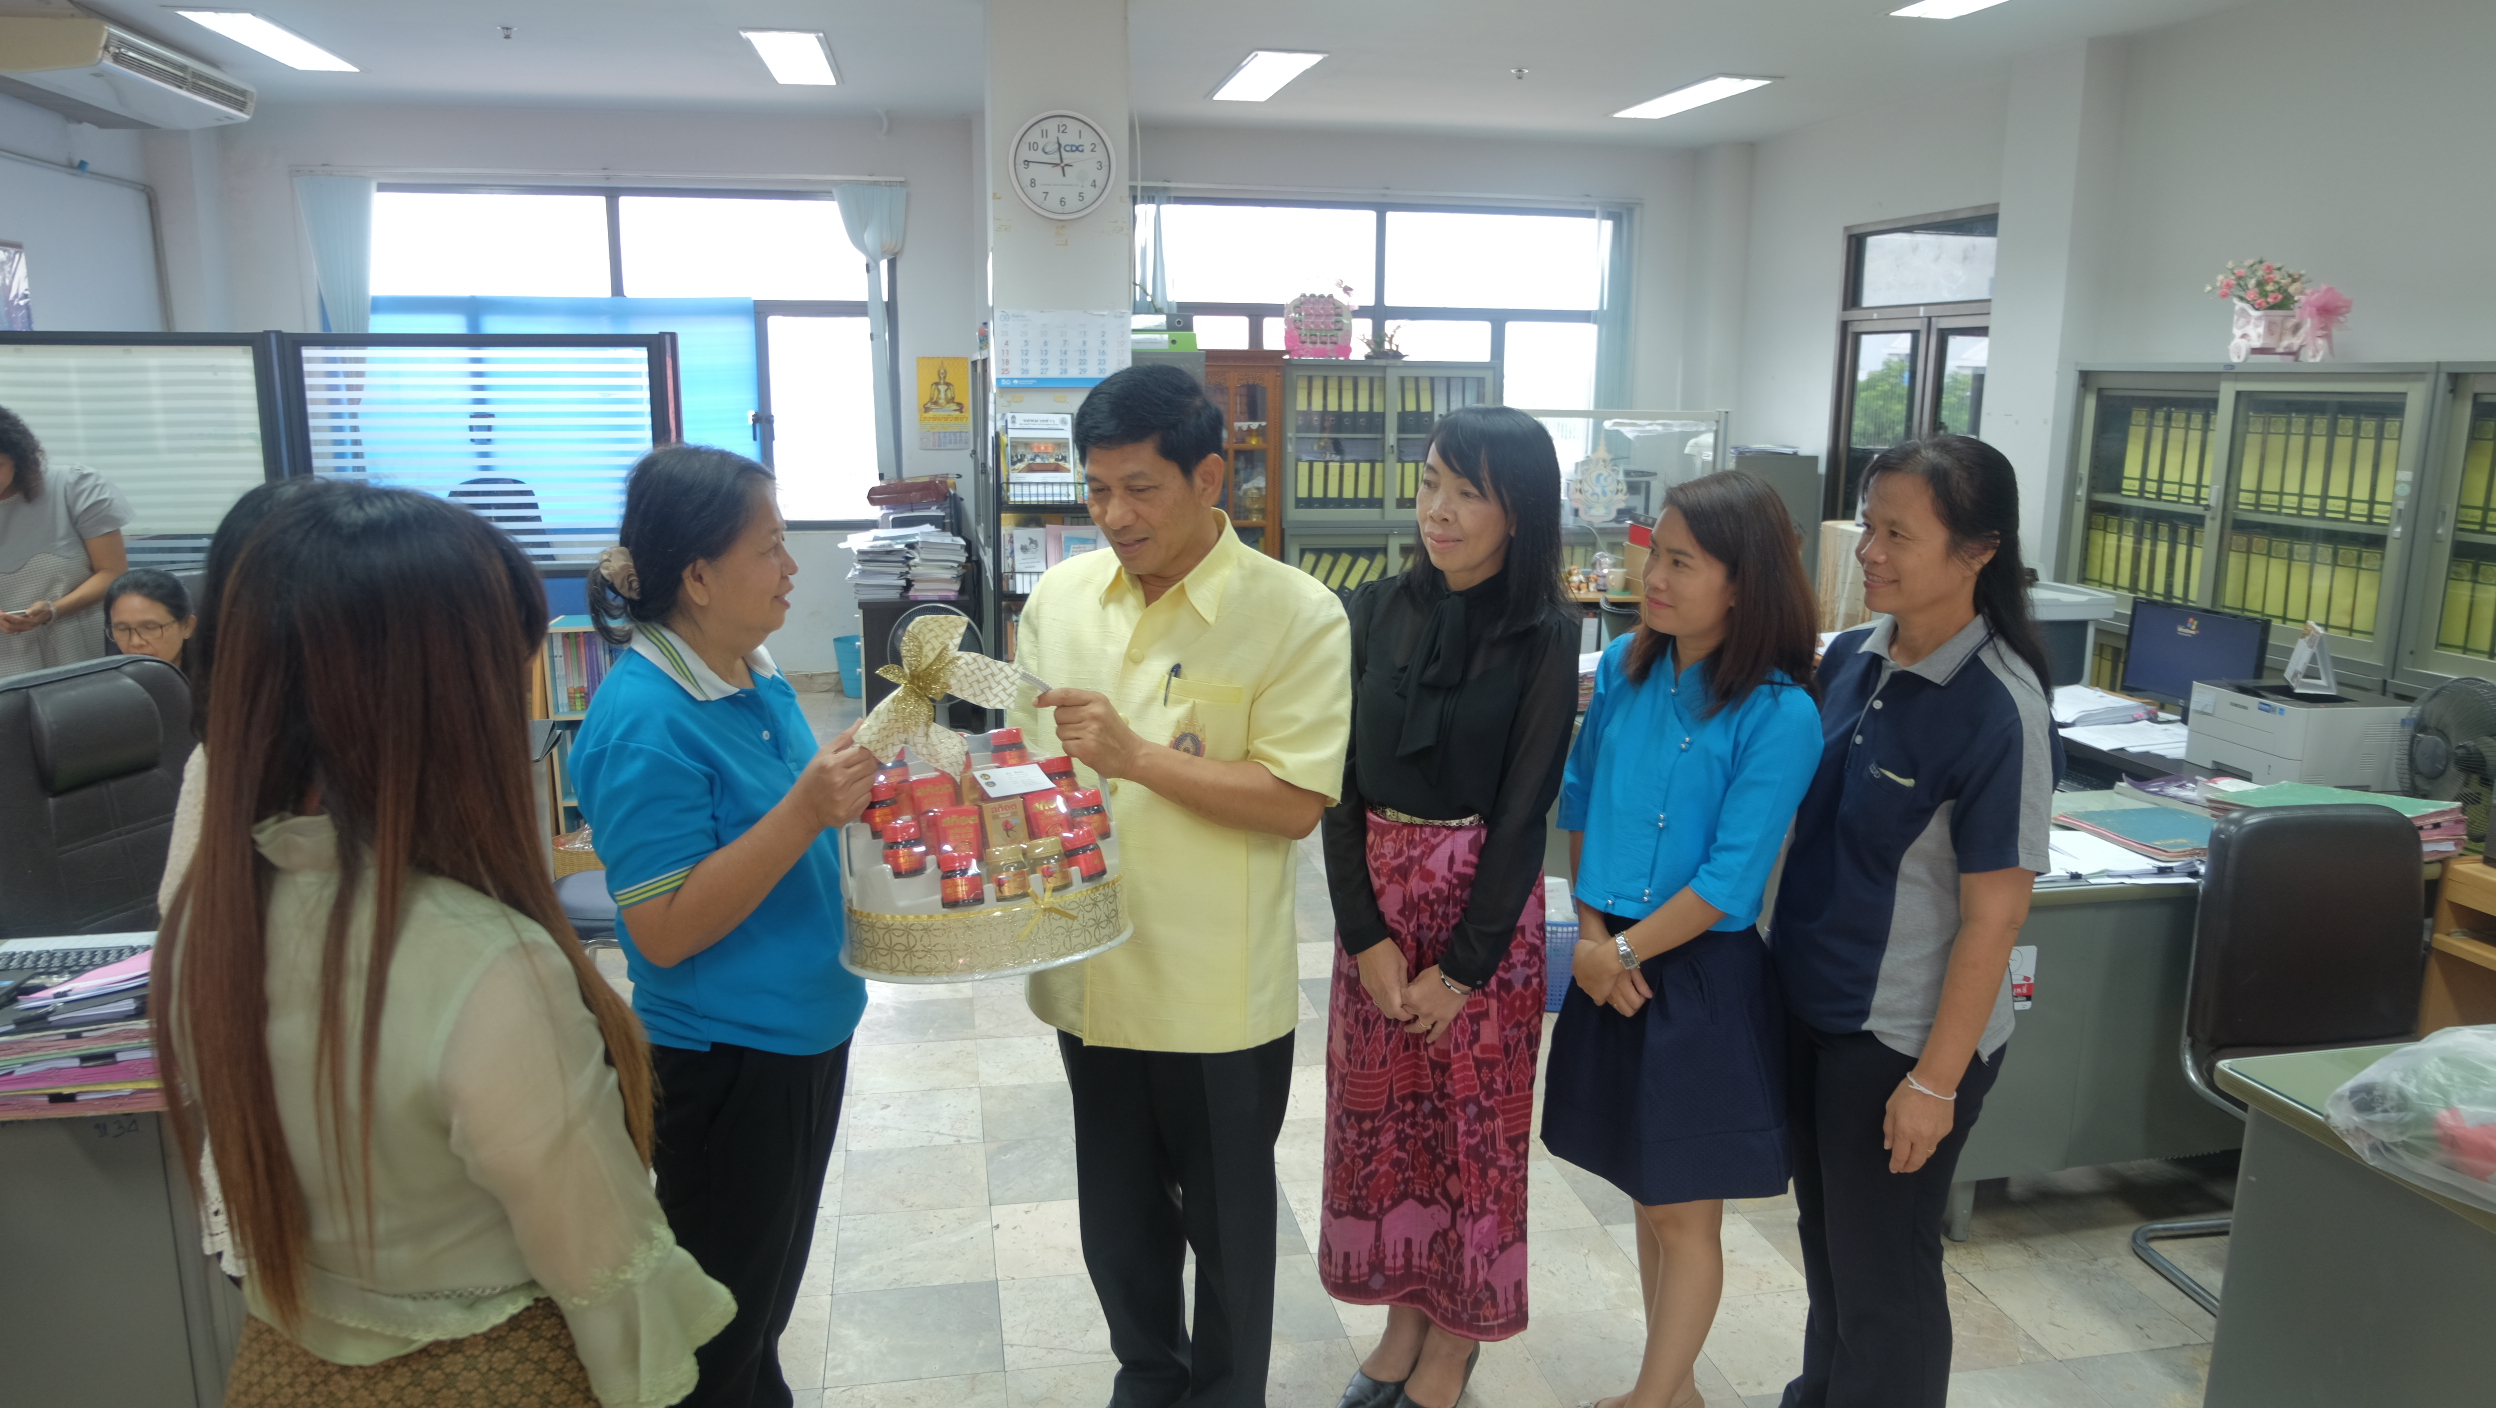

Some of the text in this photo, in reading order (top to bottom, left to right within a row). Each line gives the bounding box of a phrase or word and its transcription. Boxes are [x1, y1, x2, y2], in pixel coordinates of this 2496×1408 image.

[1040, 129, 1048, 139] 11
[1057, 124, 1068, 134] 12
[1028, 141, 1039, 152] 10
[1063, 144, 1085, 153] CDG
[1090, 143, 1097, 153] 2
[1096, 160, 1103, 171] 3
[1029, 178, 1036, 188] 8
[1090, 179, 1097, 189] 4
[1042, 191, 1049, 201] 7
[1078, 192, 1085, 202] 5
[1059, 197, 1066, 207] 6
